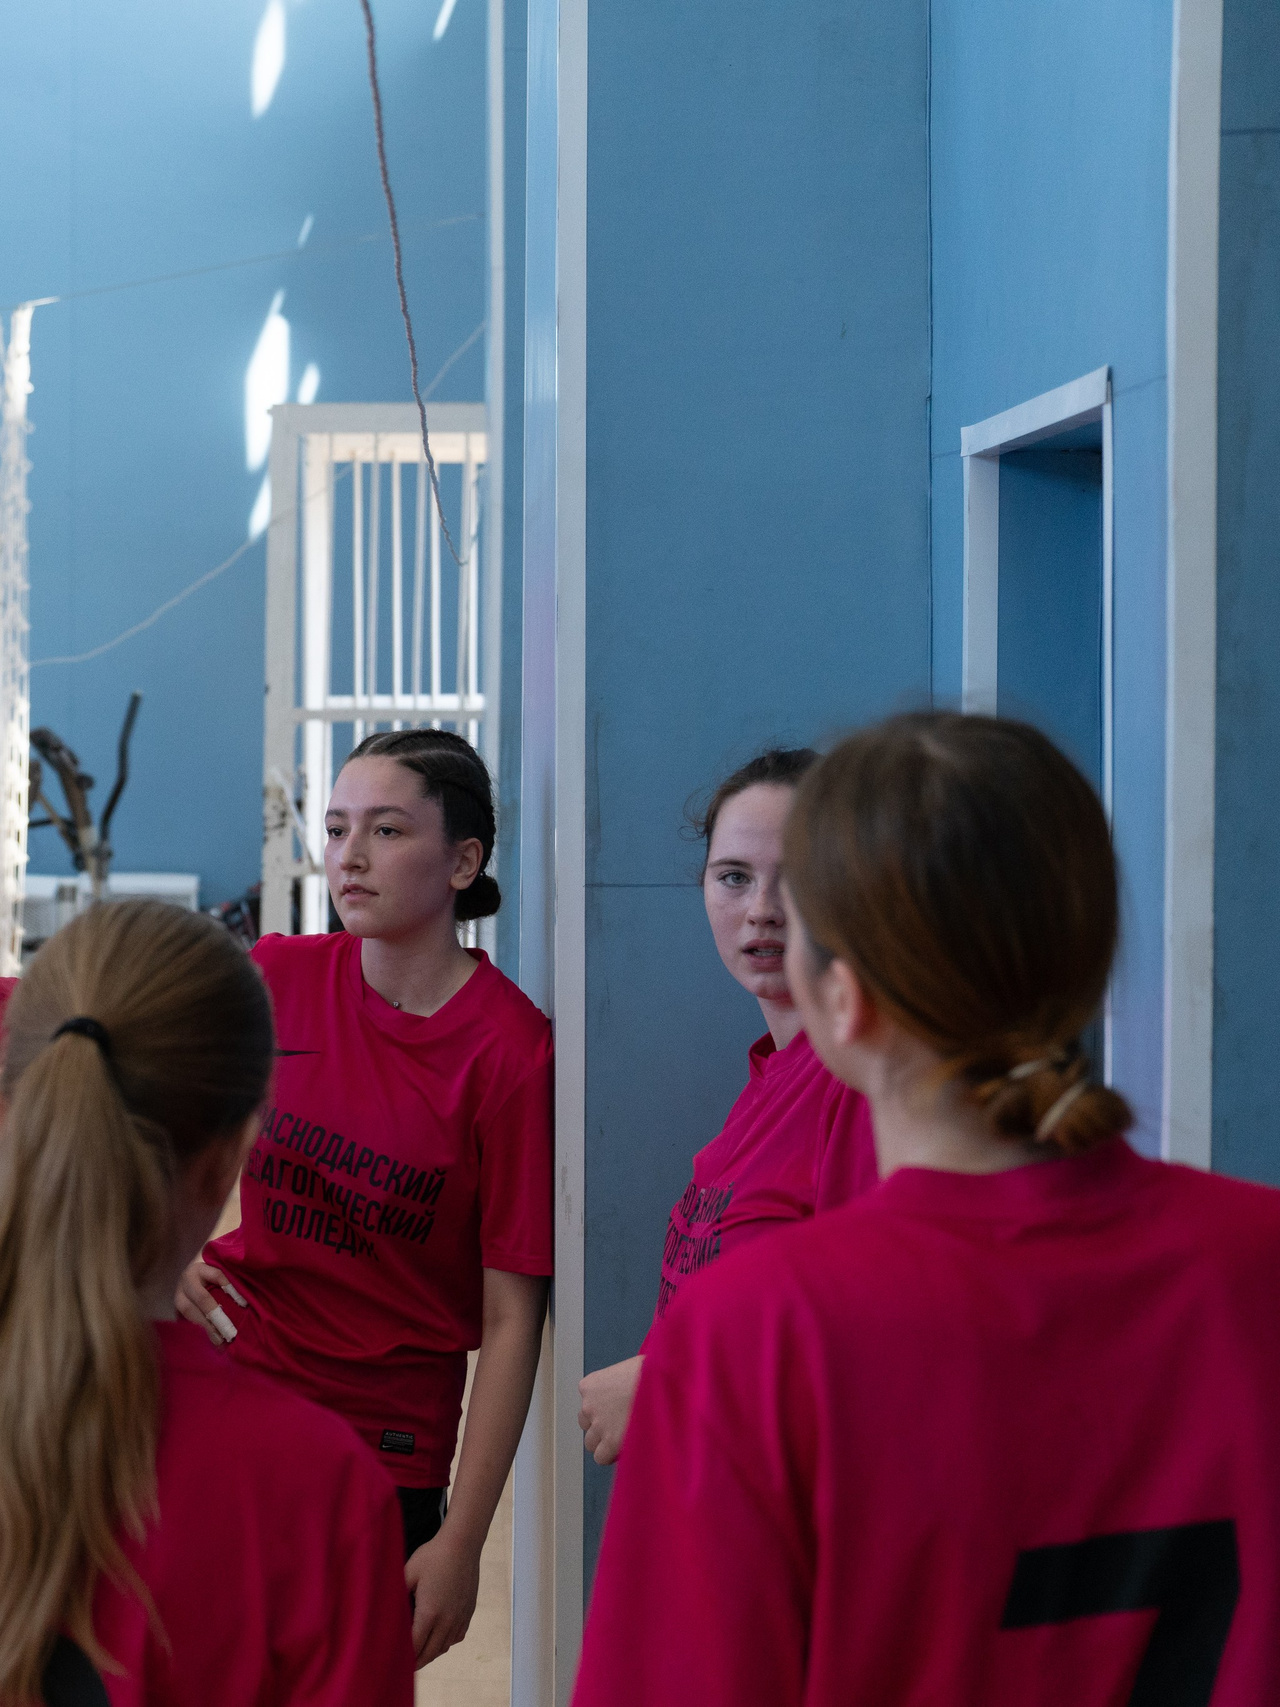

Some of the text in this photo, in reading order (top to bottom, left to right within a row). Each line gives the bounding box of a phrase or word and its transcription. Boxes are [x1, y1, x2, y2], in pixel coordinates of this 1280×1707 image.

[247, 1148, 436, 1245] ЕДАГОГИЧЕСКИЙ
[260, 1105, 447, 1206] АСНОДАРСКИЙ
[998, 1517, 1242, 1707] 7
